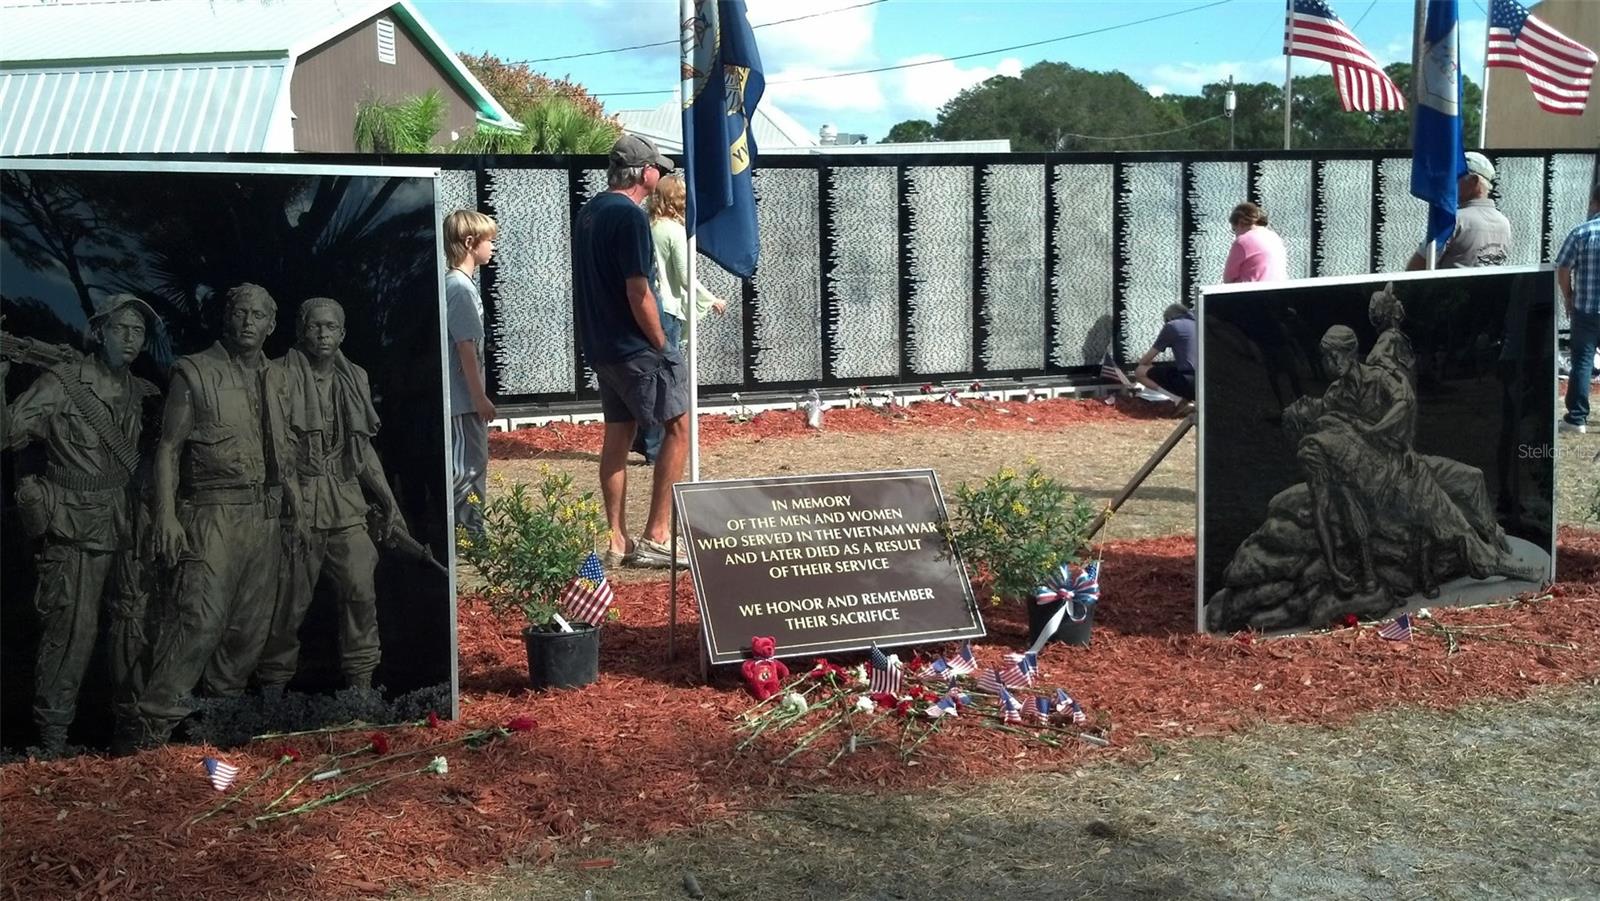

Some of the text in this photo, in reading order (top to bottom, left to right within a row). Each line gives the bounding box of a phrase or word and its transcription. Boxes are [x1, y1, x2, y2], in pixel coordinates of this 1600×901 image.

[771, 495, 852, 511] IN MEMORY
[727, 508, 903, 531] OF THE MEN AND WOMEN
[697, 522, 938, 550] WHO SERVED IN THE VIETNAM WAR
[725, 538, 921, 565] AND LATER DIED AS A RESULT
[769, 557, 890, 579] OF THEIR SERVICE
[739, 588, 935, 617] WE HONOR AND REMEMBER
[785, 608, 900, 630] THEIR SACRIFICE
